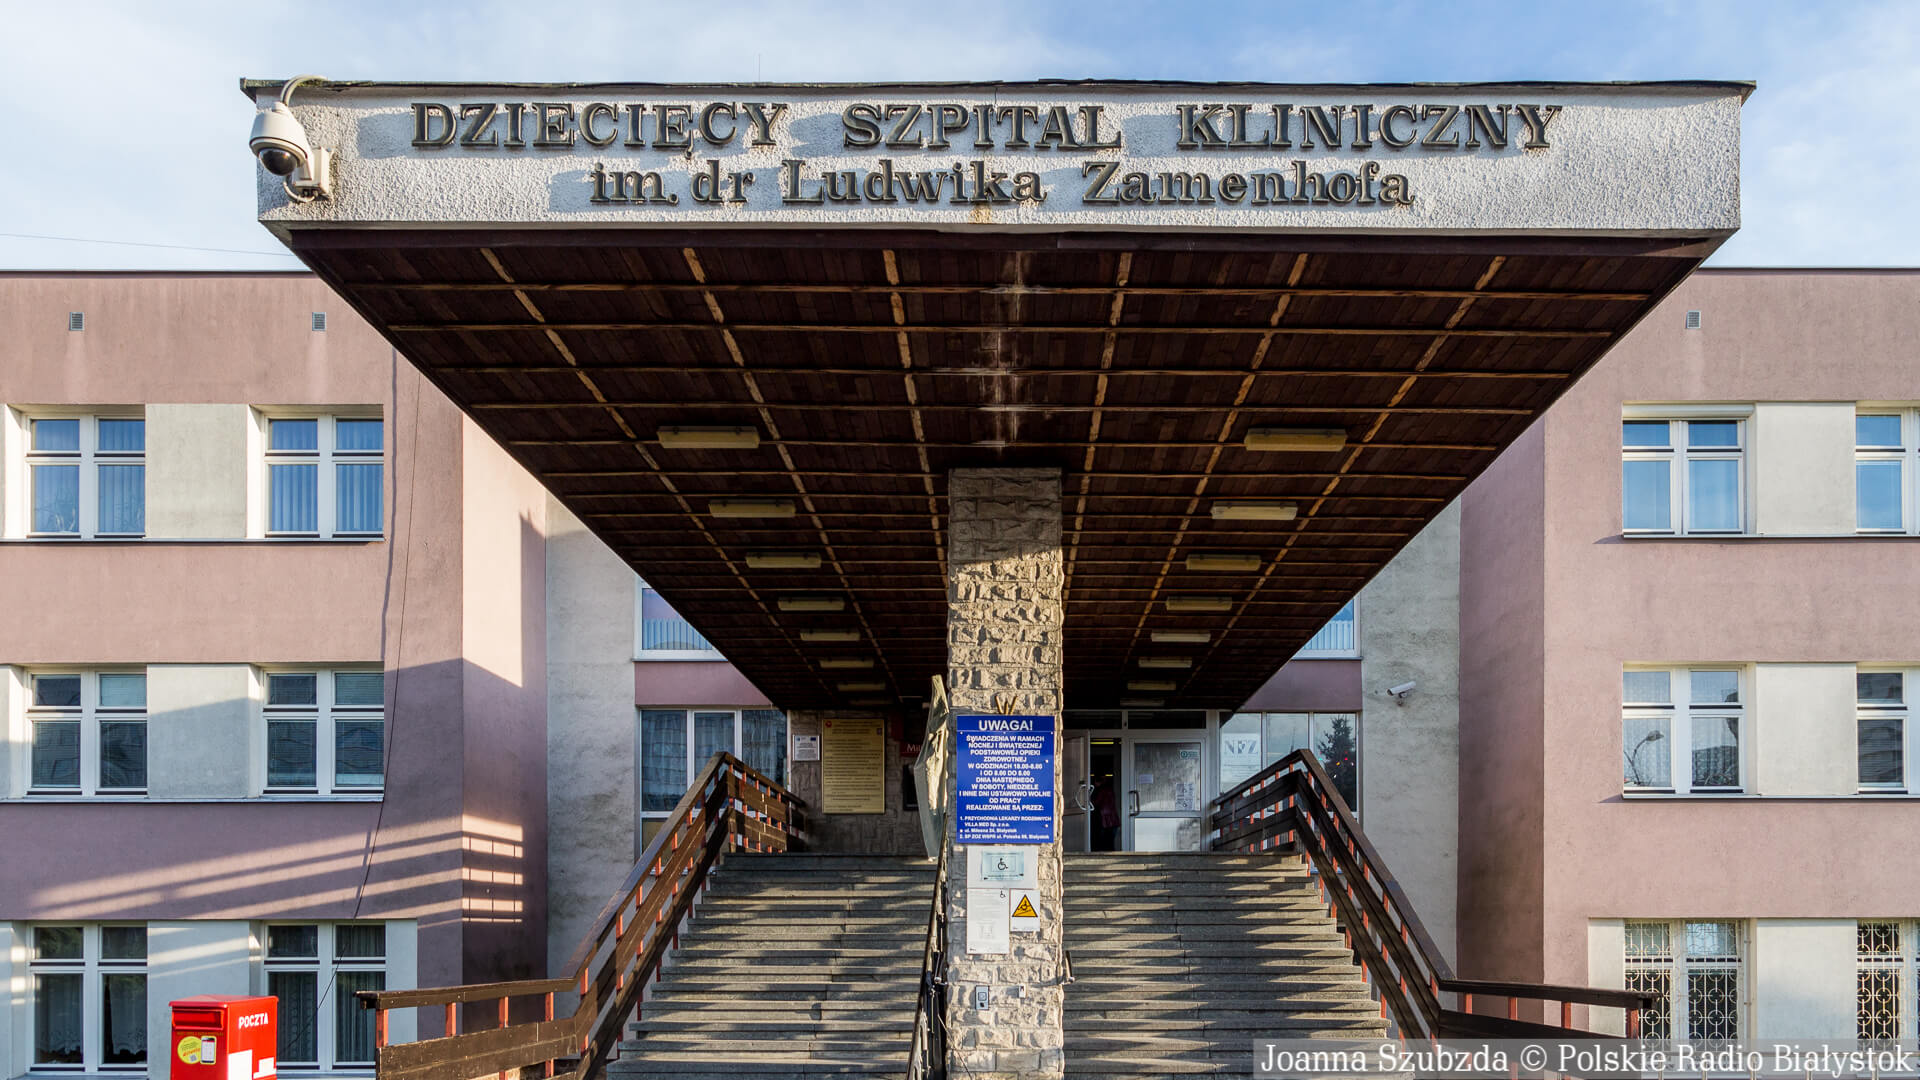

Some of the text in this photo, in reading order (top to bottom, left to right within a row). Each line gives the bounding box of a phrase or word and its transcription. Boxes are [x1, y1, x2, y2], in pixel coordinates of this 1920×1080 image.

[411, 101, 1563, 160] DZIECIĘCY SZPITAL KLINICZNY
[589, 159, 1415, 206] im. dr Ludwika Zamenhofa
[978, 720, 1033, 731] UWAGA!
[238, 1012, 269, 1030] POCZTA
